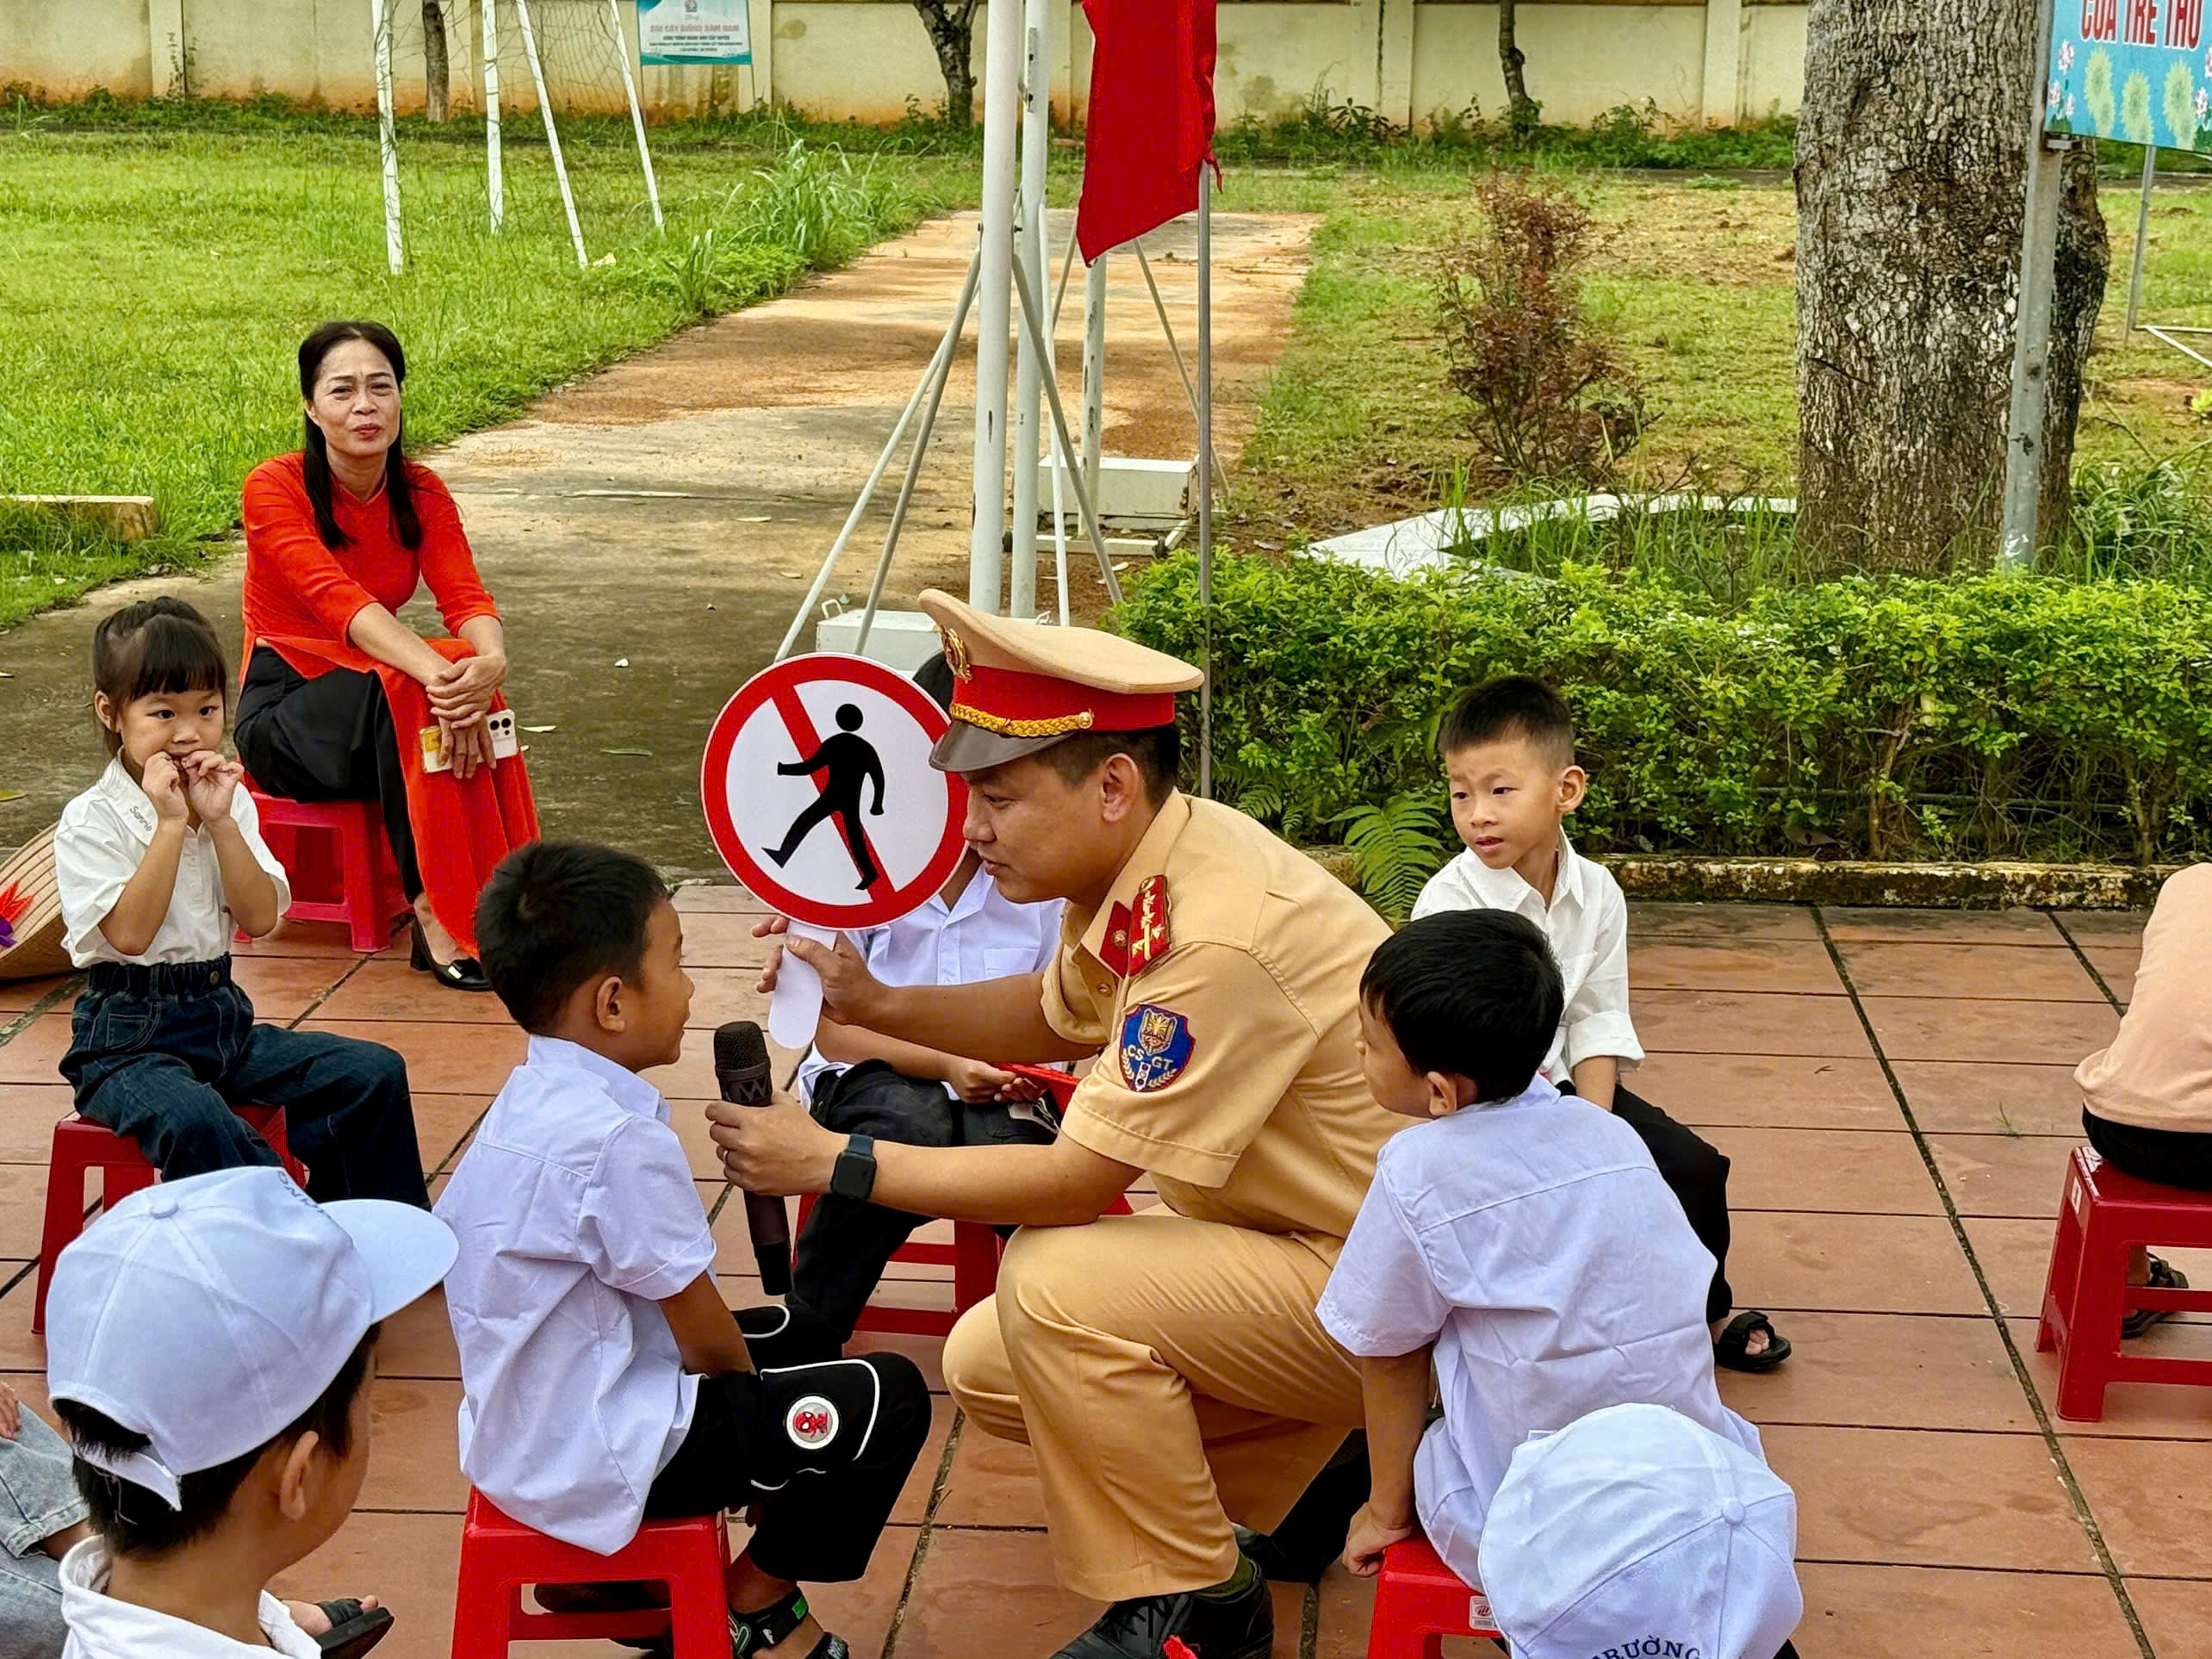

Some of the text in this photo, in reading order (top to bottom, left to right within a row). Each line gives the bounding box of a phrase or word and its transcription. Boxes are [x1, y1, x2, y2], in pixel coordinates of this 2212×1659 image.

[129, 805, 152, 832] Sanrio
[1127, 1044, 1174, 1071] CS GT
[1592, 1635, 1701, 1659] RƯỜNG
